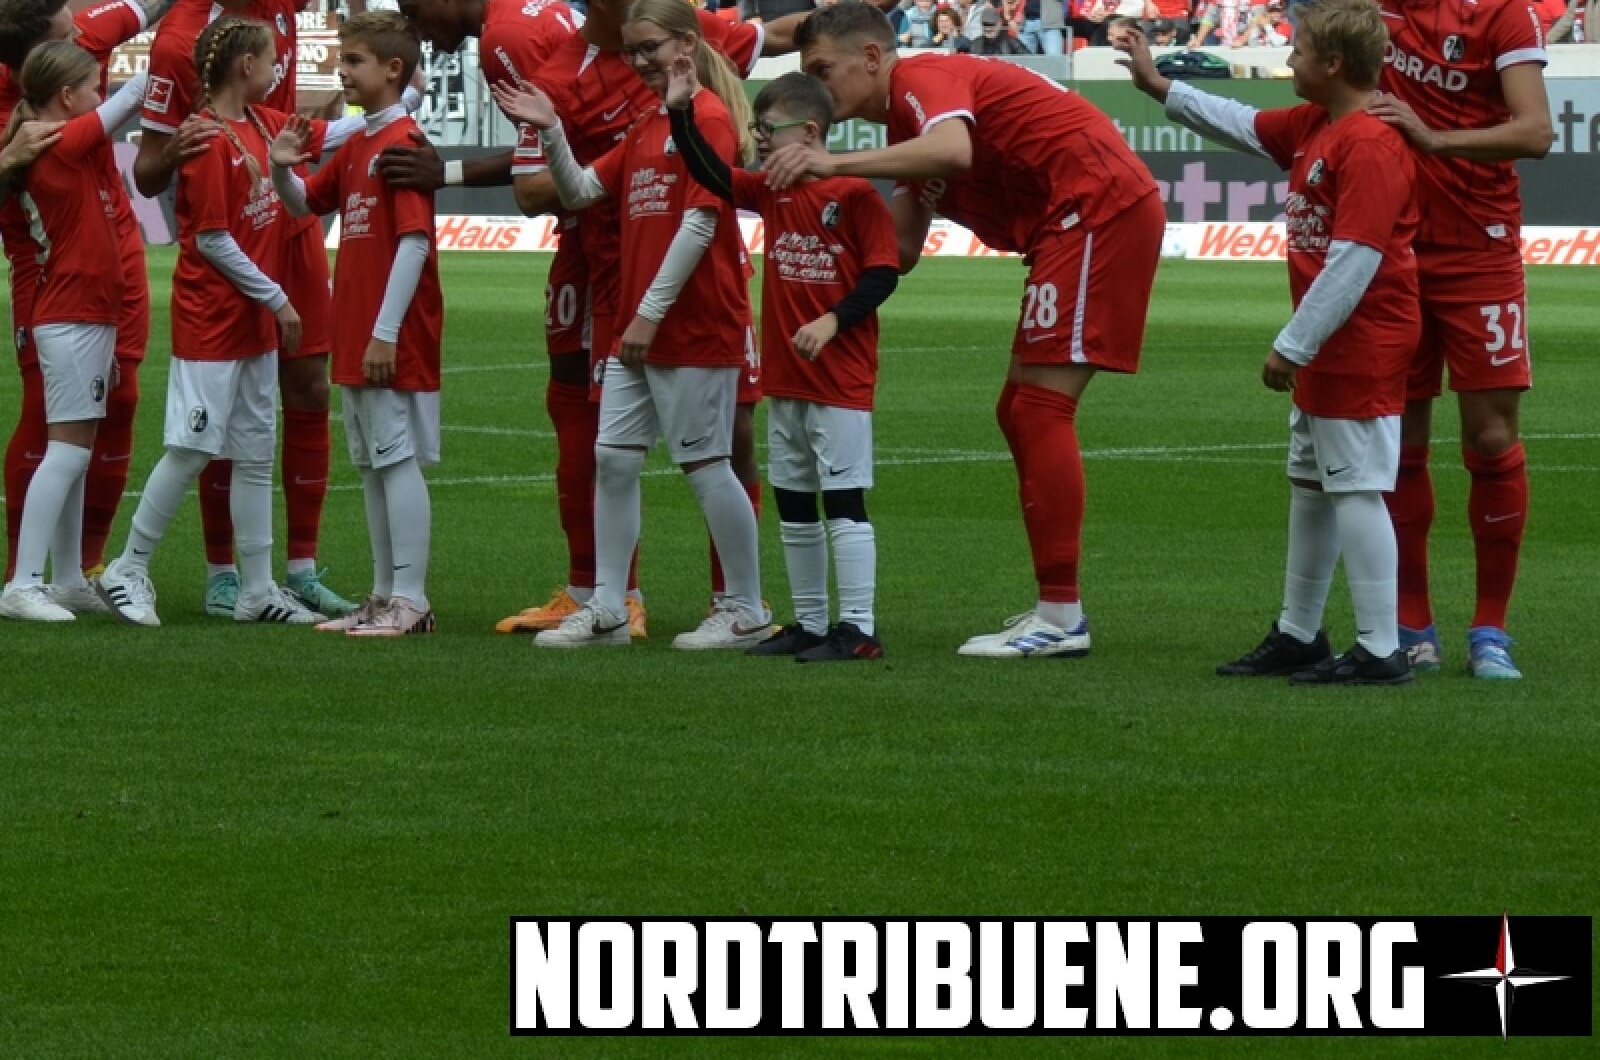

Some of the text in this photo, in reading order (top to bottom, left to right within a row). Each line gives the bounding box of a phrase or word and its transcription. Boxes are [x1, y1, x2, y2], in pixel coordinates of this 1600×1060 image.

[1383, 41, 1469, 93] OBRAD
[1198, 223, 1289, 259] Webe
[545, 283, 577, 327] 20
[1023, 282, 1058, 330] 28
[1479, 302, 1524, 352] 32
